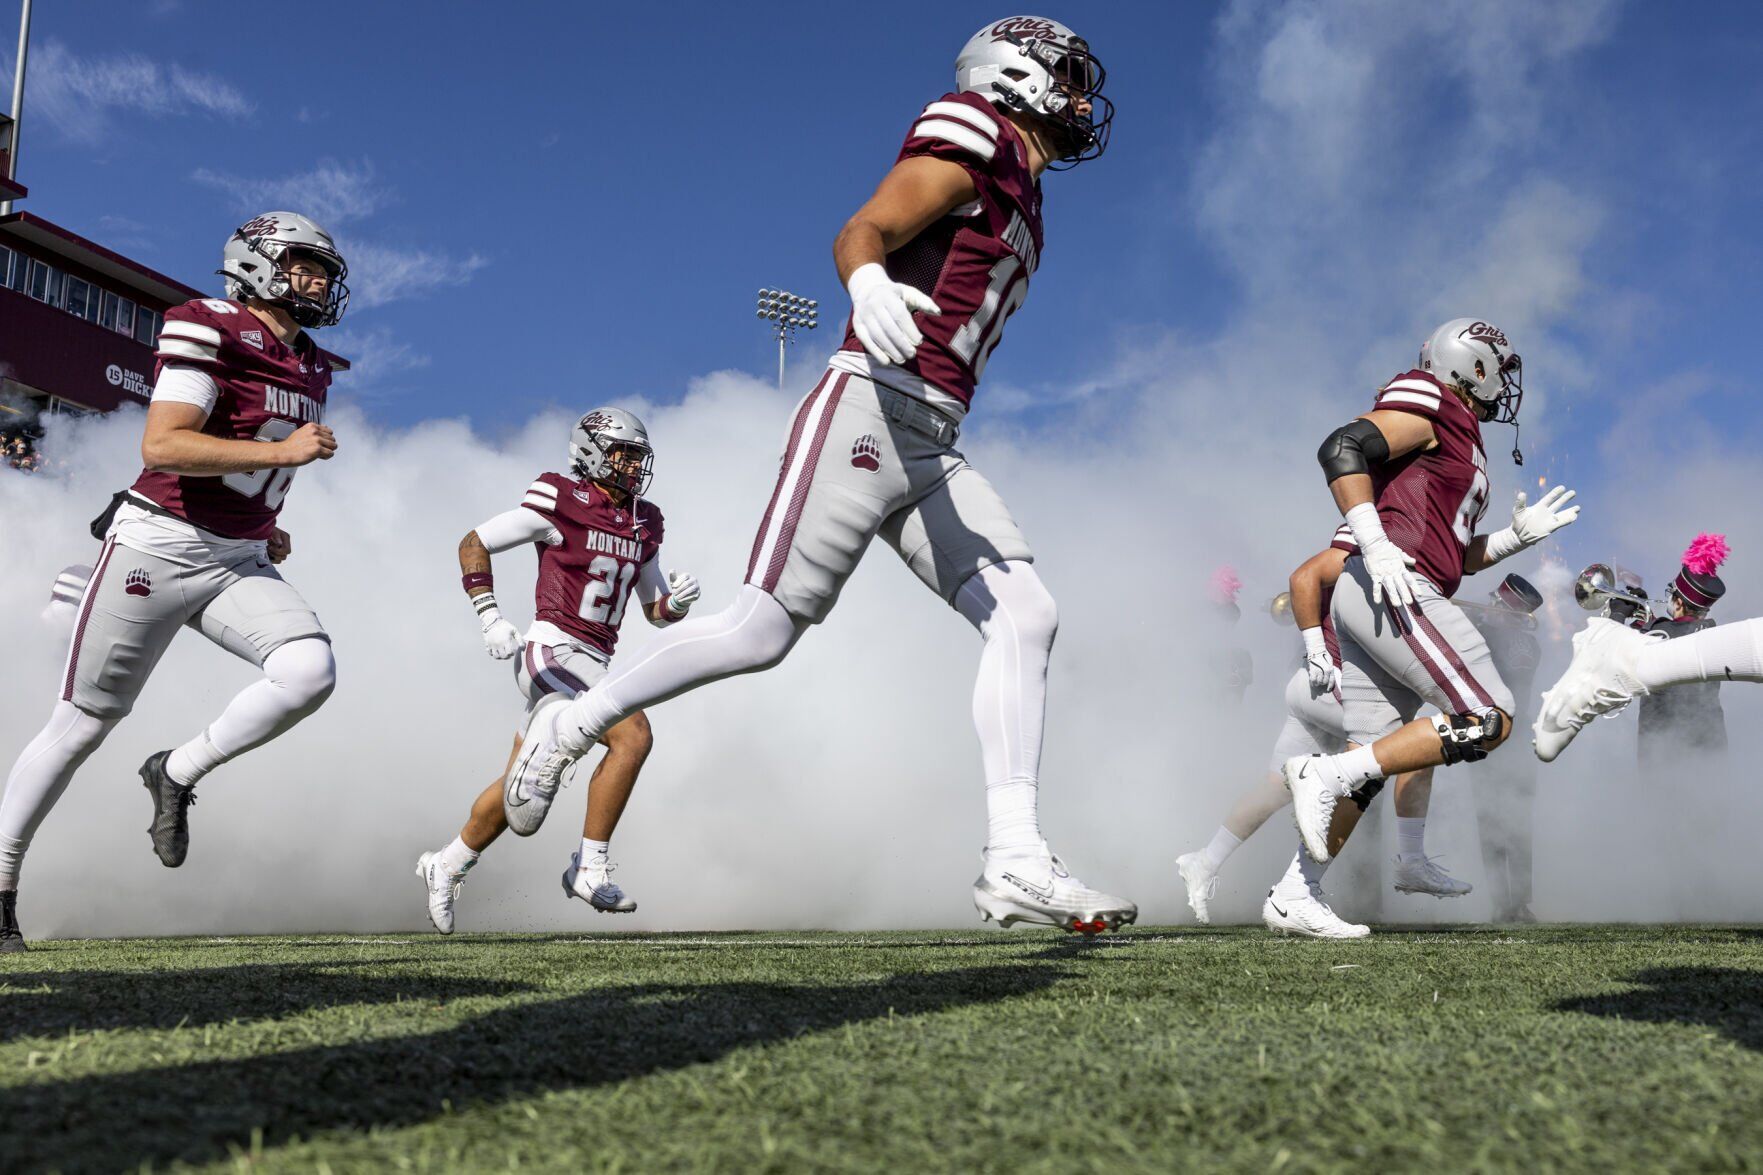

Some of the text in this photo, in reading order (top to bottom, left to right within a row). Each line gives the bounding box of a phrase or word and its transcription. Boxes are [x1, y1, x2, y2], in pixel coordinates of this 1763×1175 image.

[991, 16, 1057, 43] Griz
[1467, 321, 1508, 347] Griz
[109, 368, 120, 381] 15
[123, 368, 145, 383] DAVE
[264, 384, 321, 426] MONTAN
[586, 529, 643, 562] MONTANA
[578, 554, 635, 626] 21
